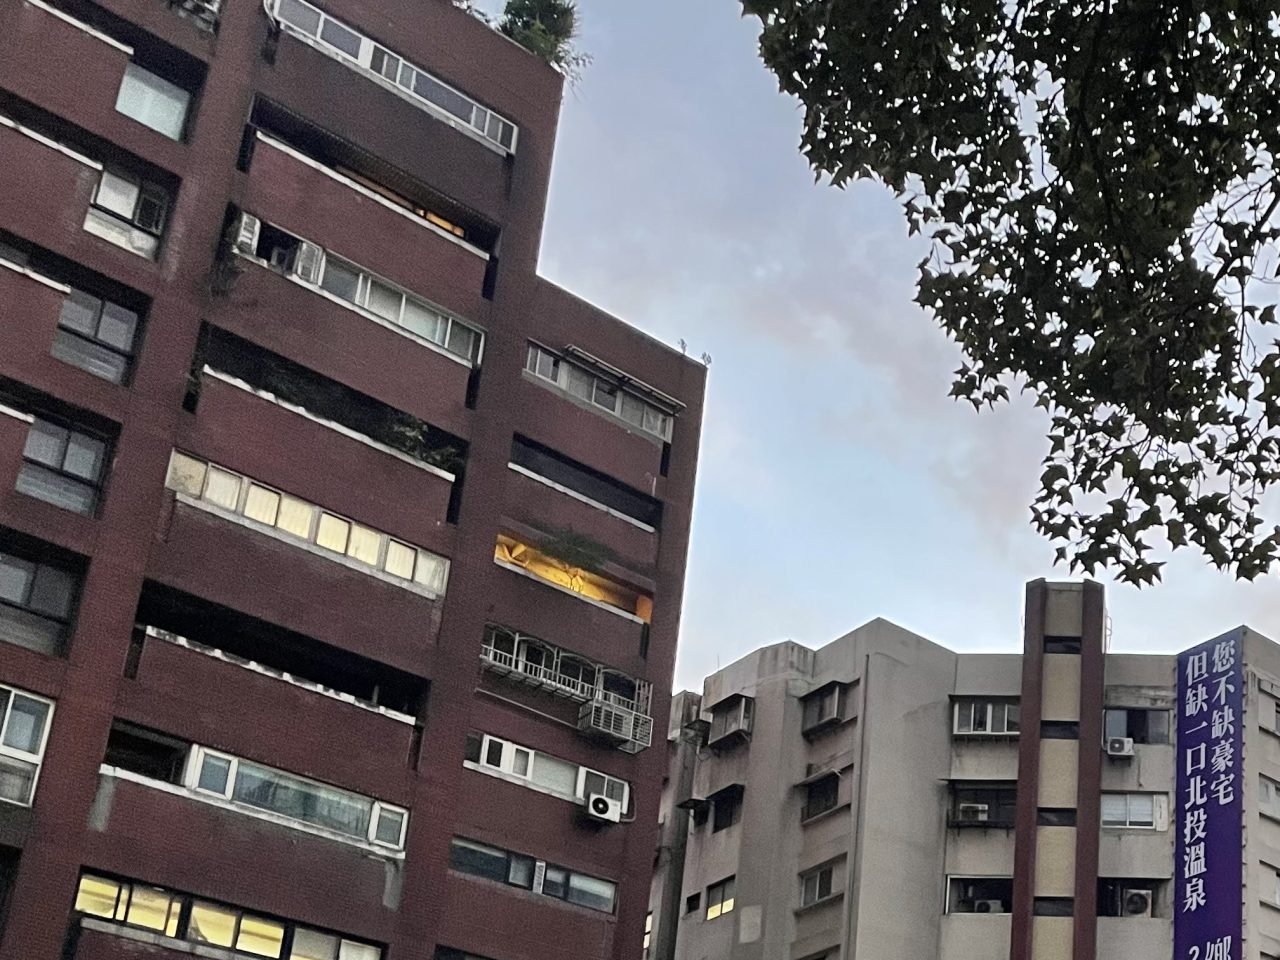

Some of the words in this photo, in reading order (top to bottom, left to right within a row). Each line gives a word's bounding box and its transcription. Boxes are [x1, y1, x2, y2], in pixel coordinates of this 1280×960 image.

[1183, 651, 1208, 913] 但缺一口北投溫泉
[1210, 640, 1236, 806] 您不缺豪宅
